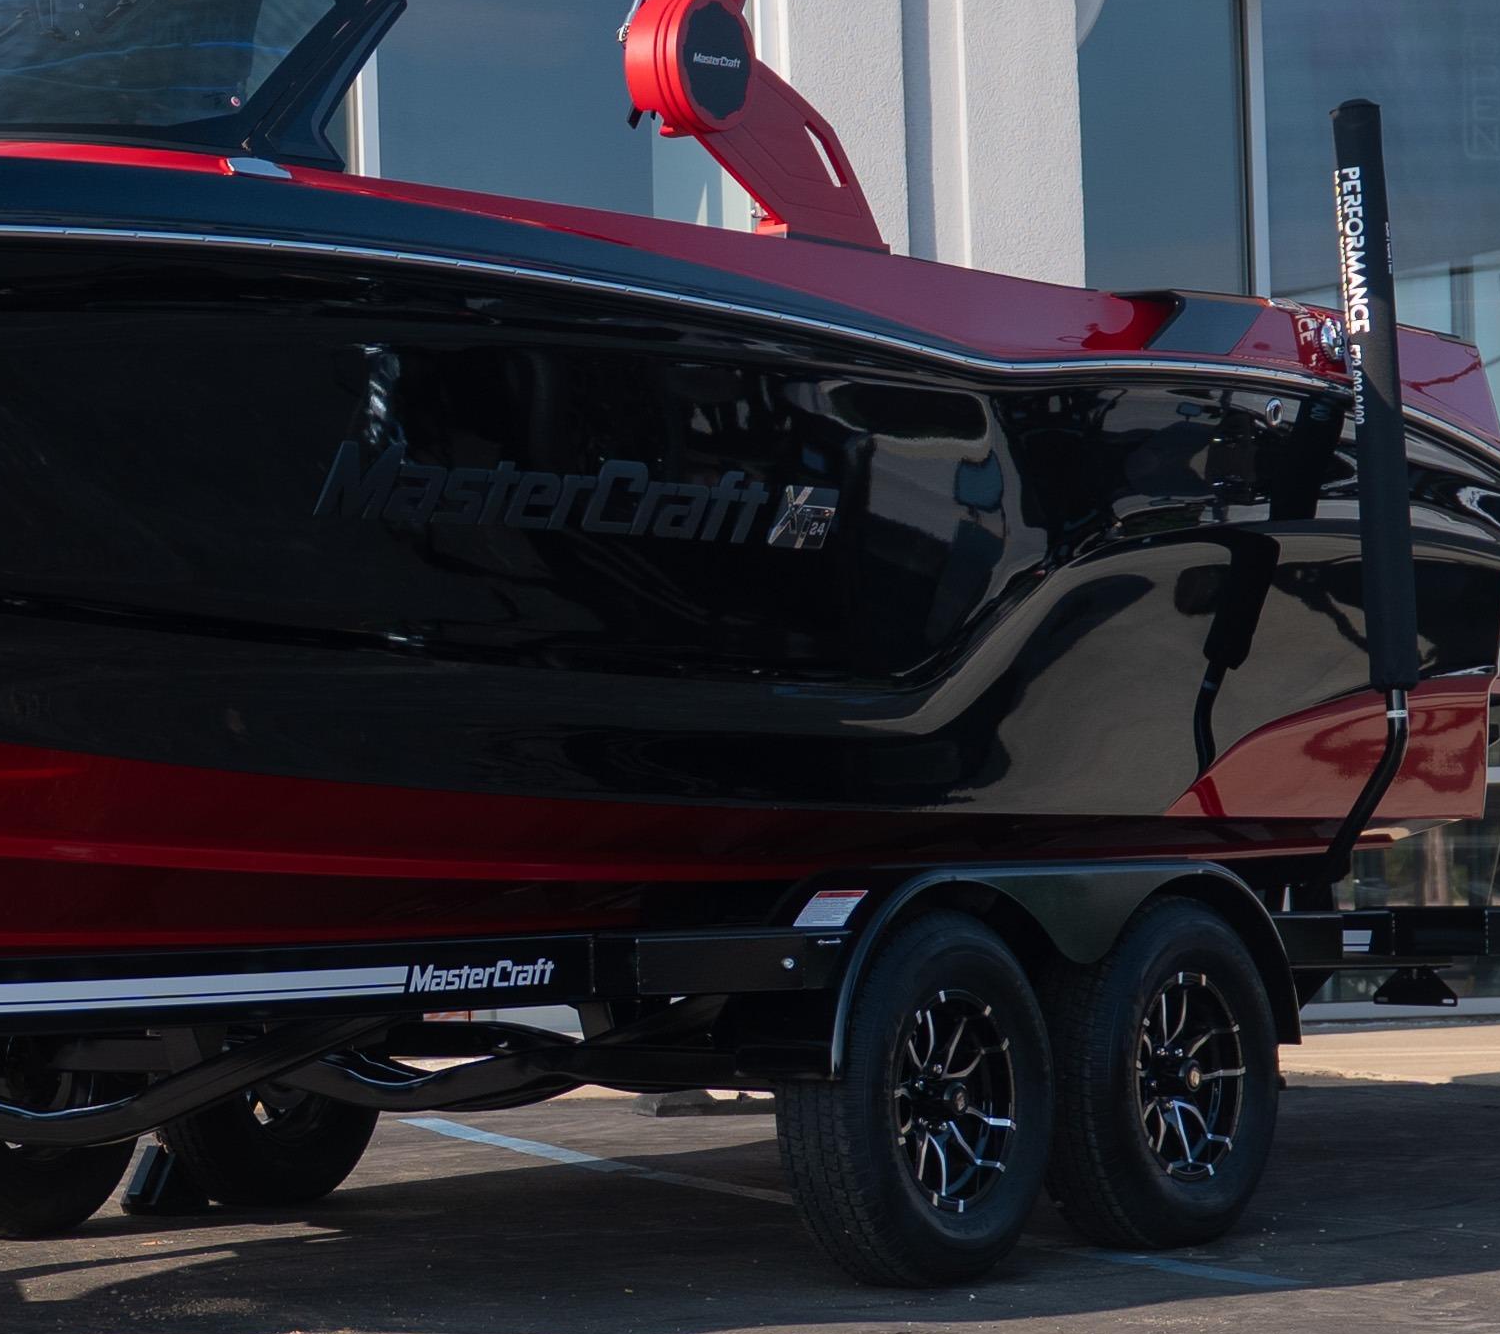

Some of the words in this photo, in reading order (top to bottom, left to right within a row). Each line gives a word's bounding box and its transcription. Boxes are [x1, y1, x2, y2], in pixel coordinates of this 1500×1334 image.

[693, 52, 741, 69] MasterCraft
[1340, 166, 1371, 335] PERFORMANCE
[312, 440, 768, 544] MasterCraft
[808, 522, 826, 536] 24
[408, 958, 555, 994] MasterCraft
